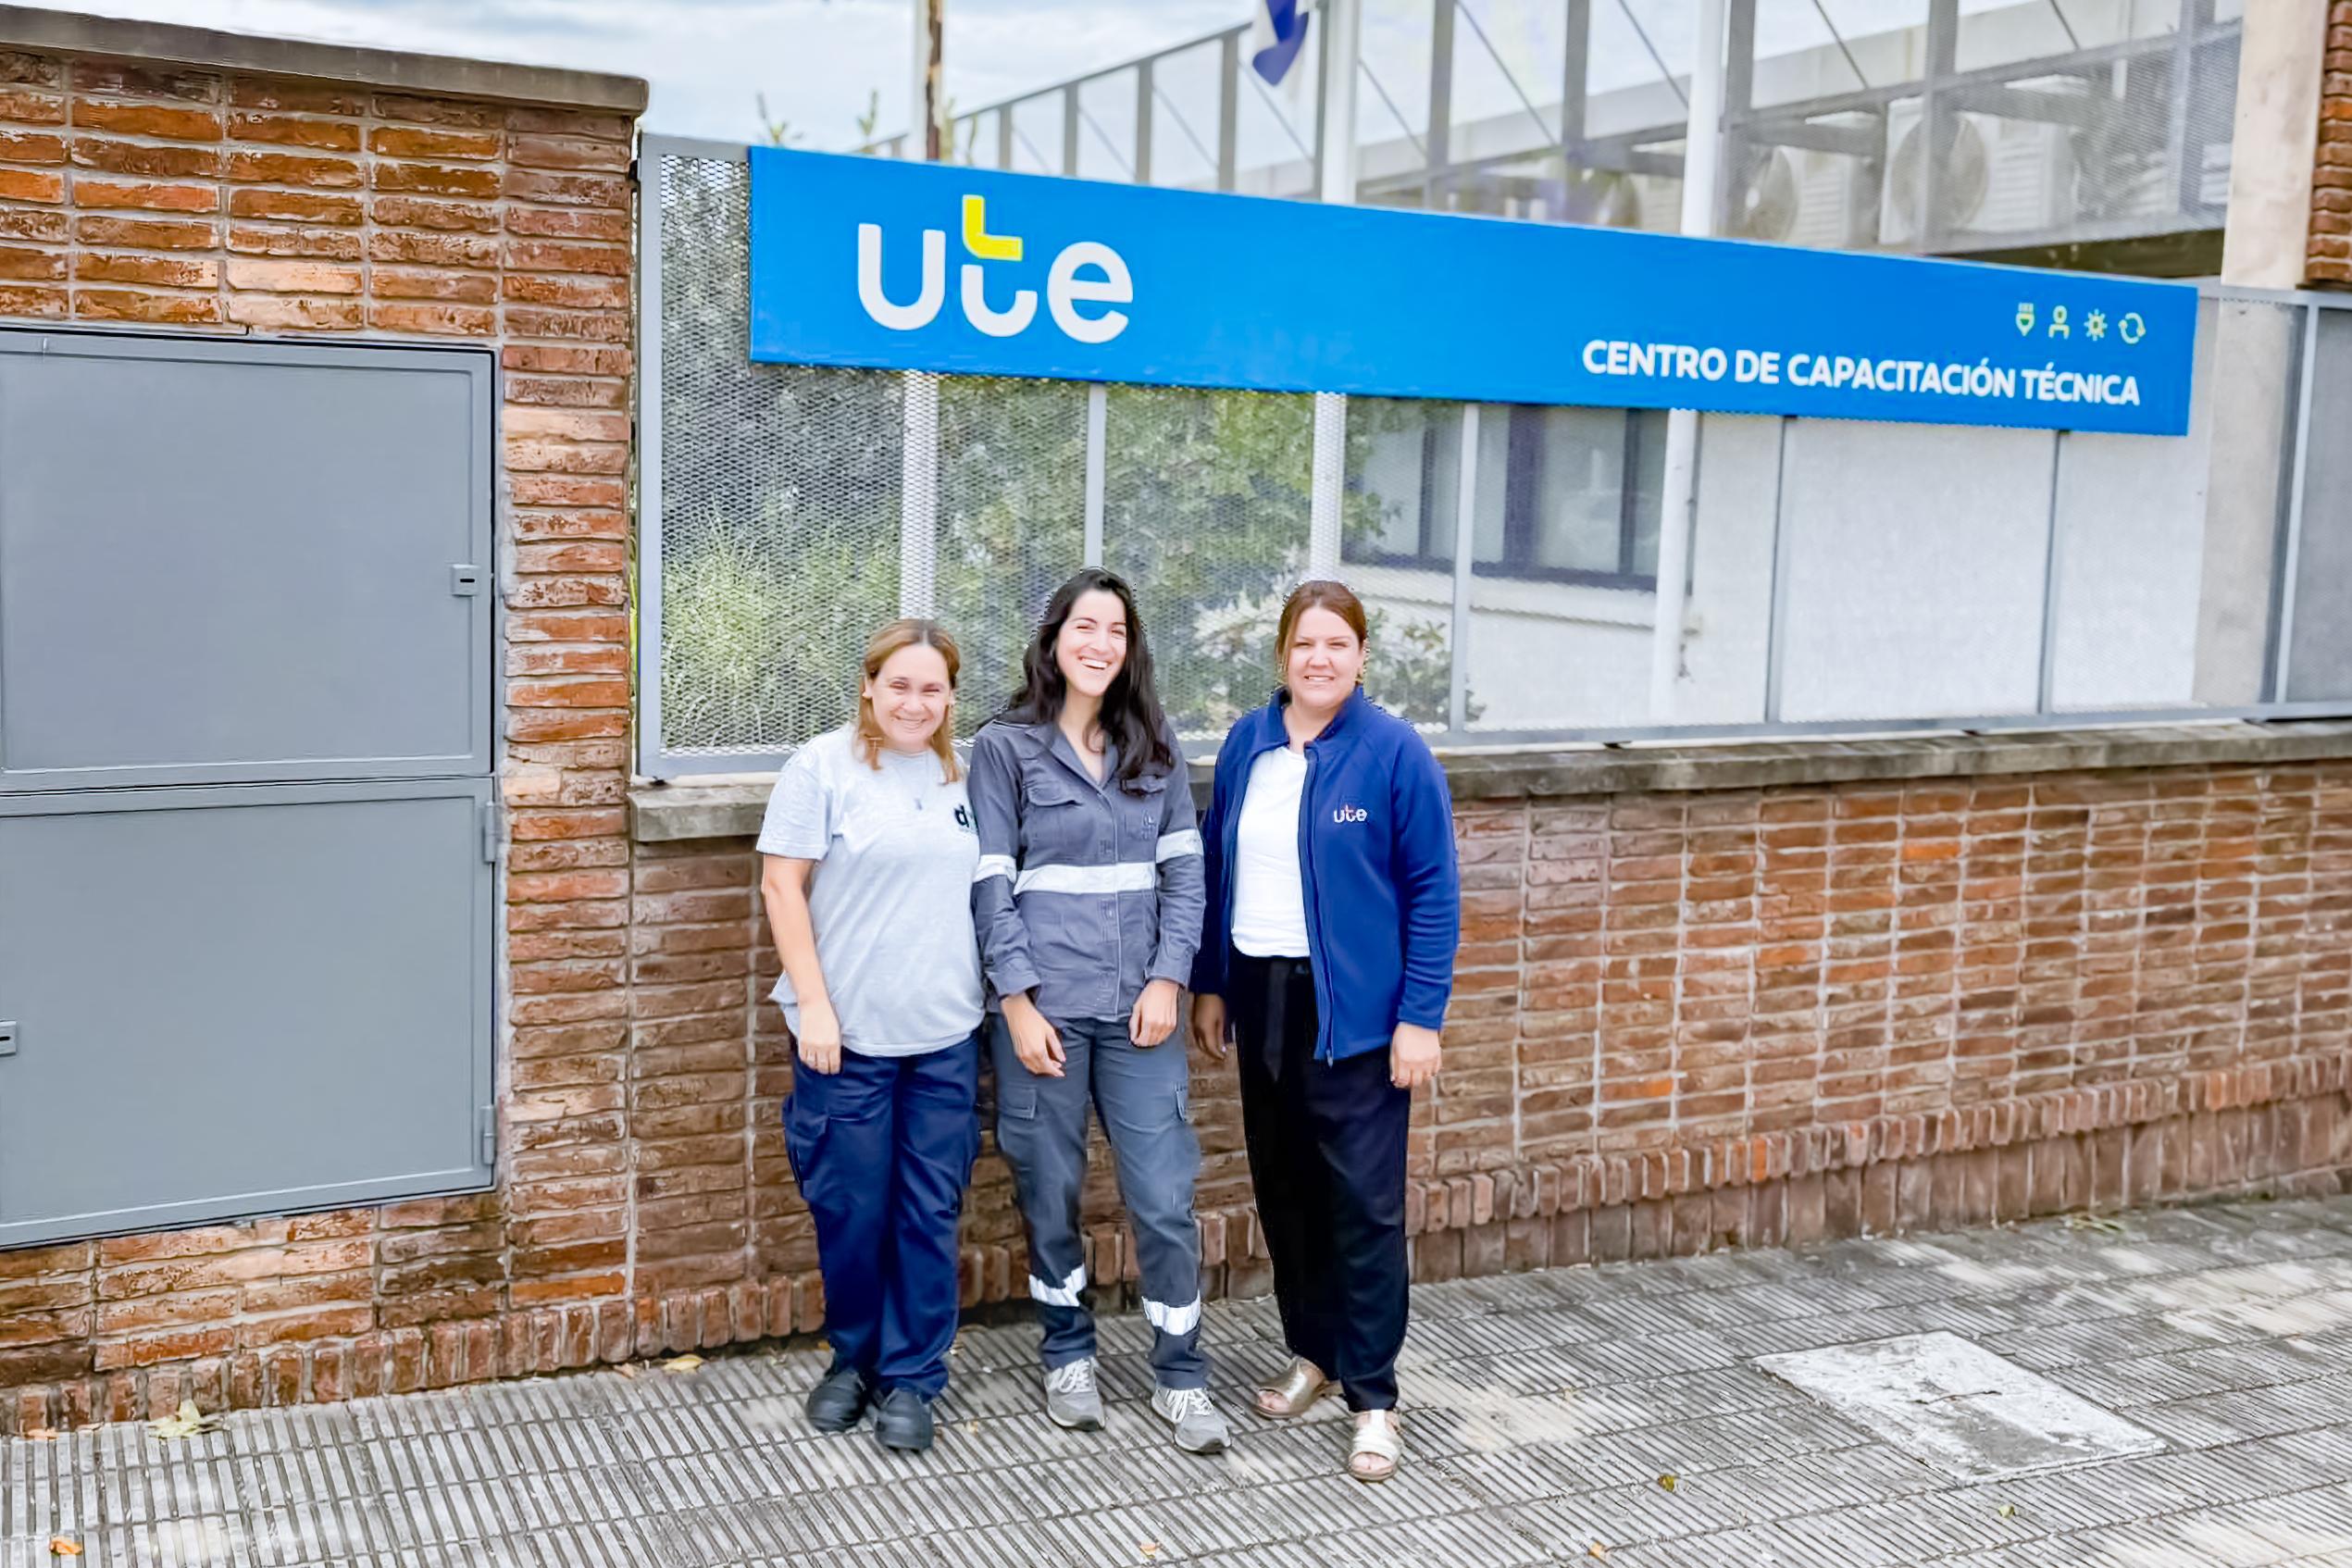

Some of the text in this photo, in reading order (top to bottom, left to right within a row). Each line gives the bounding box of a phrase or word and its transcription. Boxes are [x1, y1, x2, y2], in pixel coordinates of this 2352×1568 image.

[858, 194, 1133, 343] ute
[1582, 339, 2141, 406] CENTRO DE CAPACITACIÓN TÉCNICA
[1334, 803, 1367, 823] ute
